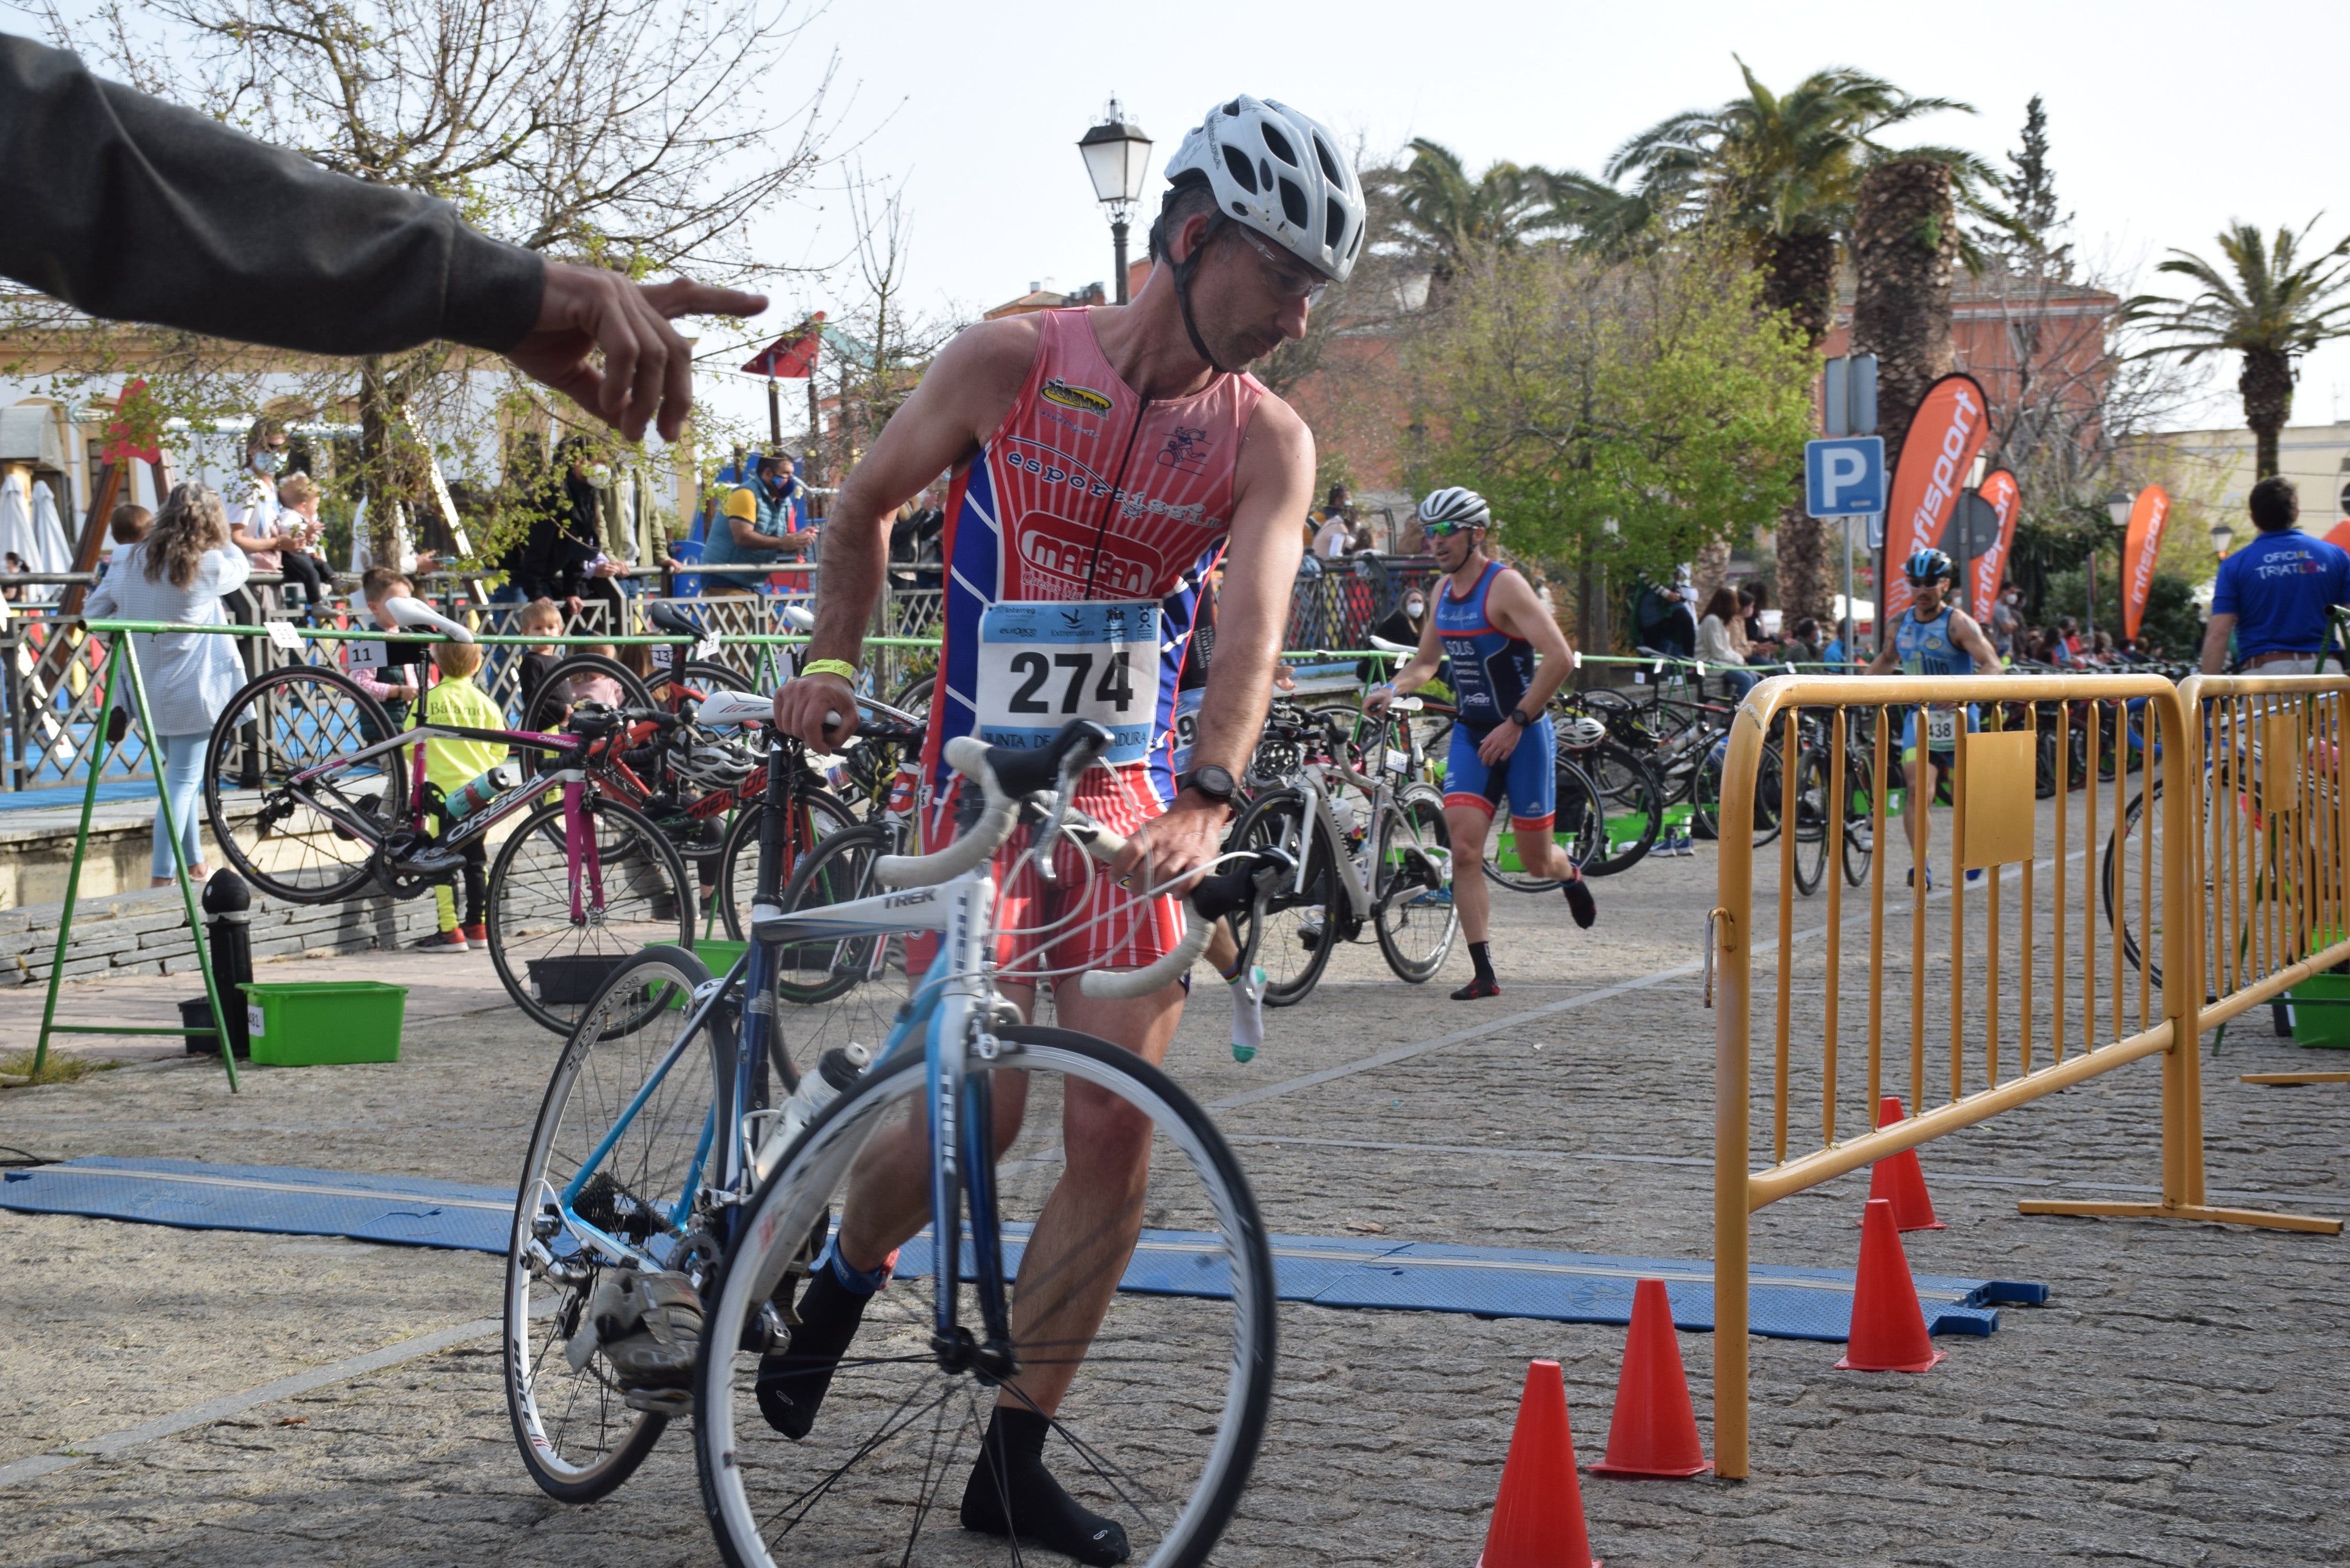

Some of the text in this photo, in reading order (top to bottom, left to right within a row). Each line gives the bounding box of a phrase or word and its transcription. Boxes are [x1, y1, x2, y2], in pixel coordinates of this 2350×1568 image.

[1822, 448, 1867, 508] P
[2132, 497, 2166, 604] infisport
[2263, 550, 2313, 563] OFICIAL
[352, 648, 373, 662] 11
[1008, 651, 1134, 714] 274
[536, 734, 579, 747] ORBEA
[985, 732, 1027, 748] JUNTA
[447, 774, 545, 843] ORBEA
[882, 889, 937, 909] TREK
[511, 1338, 534, 1431] RACE
